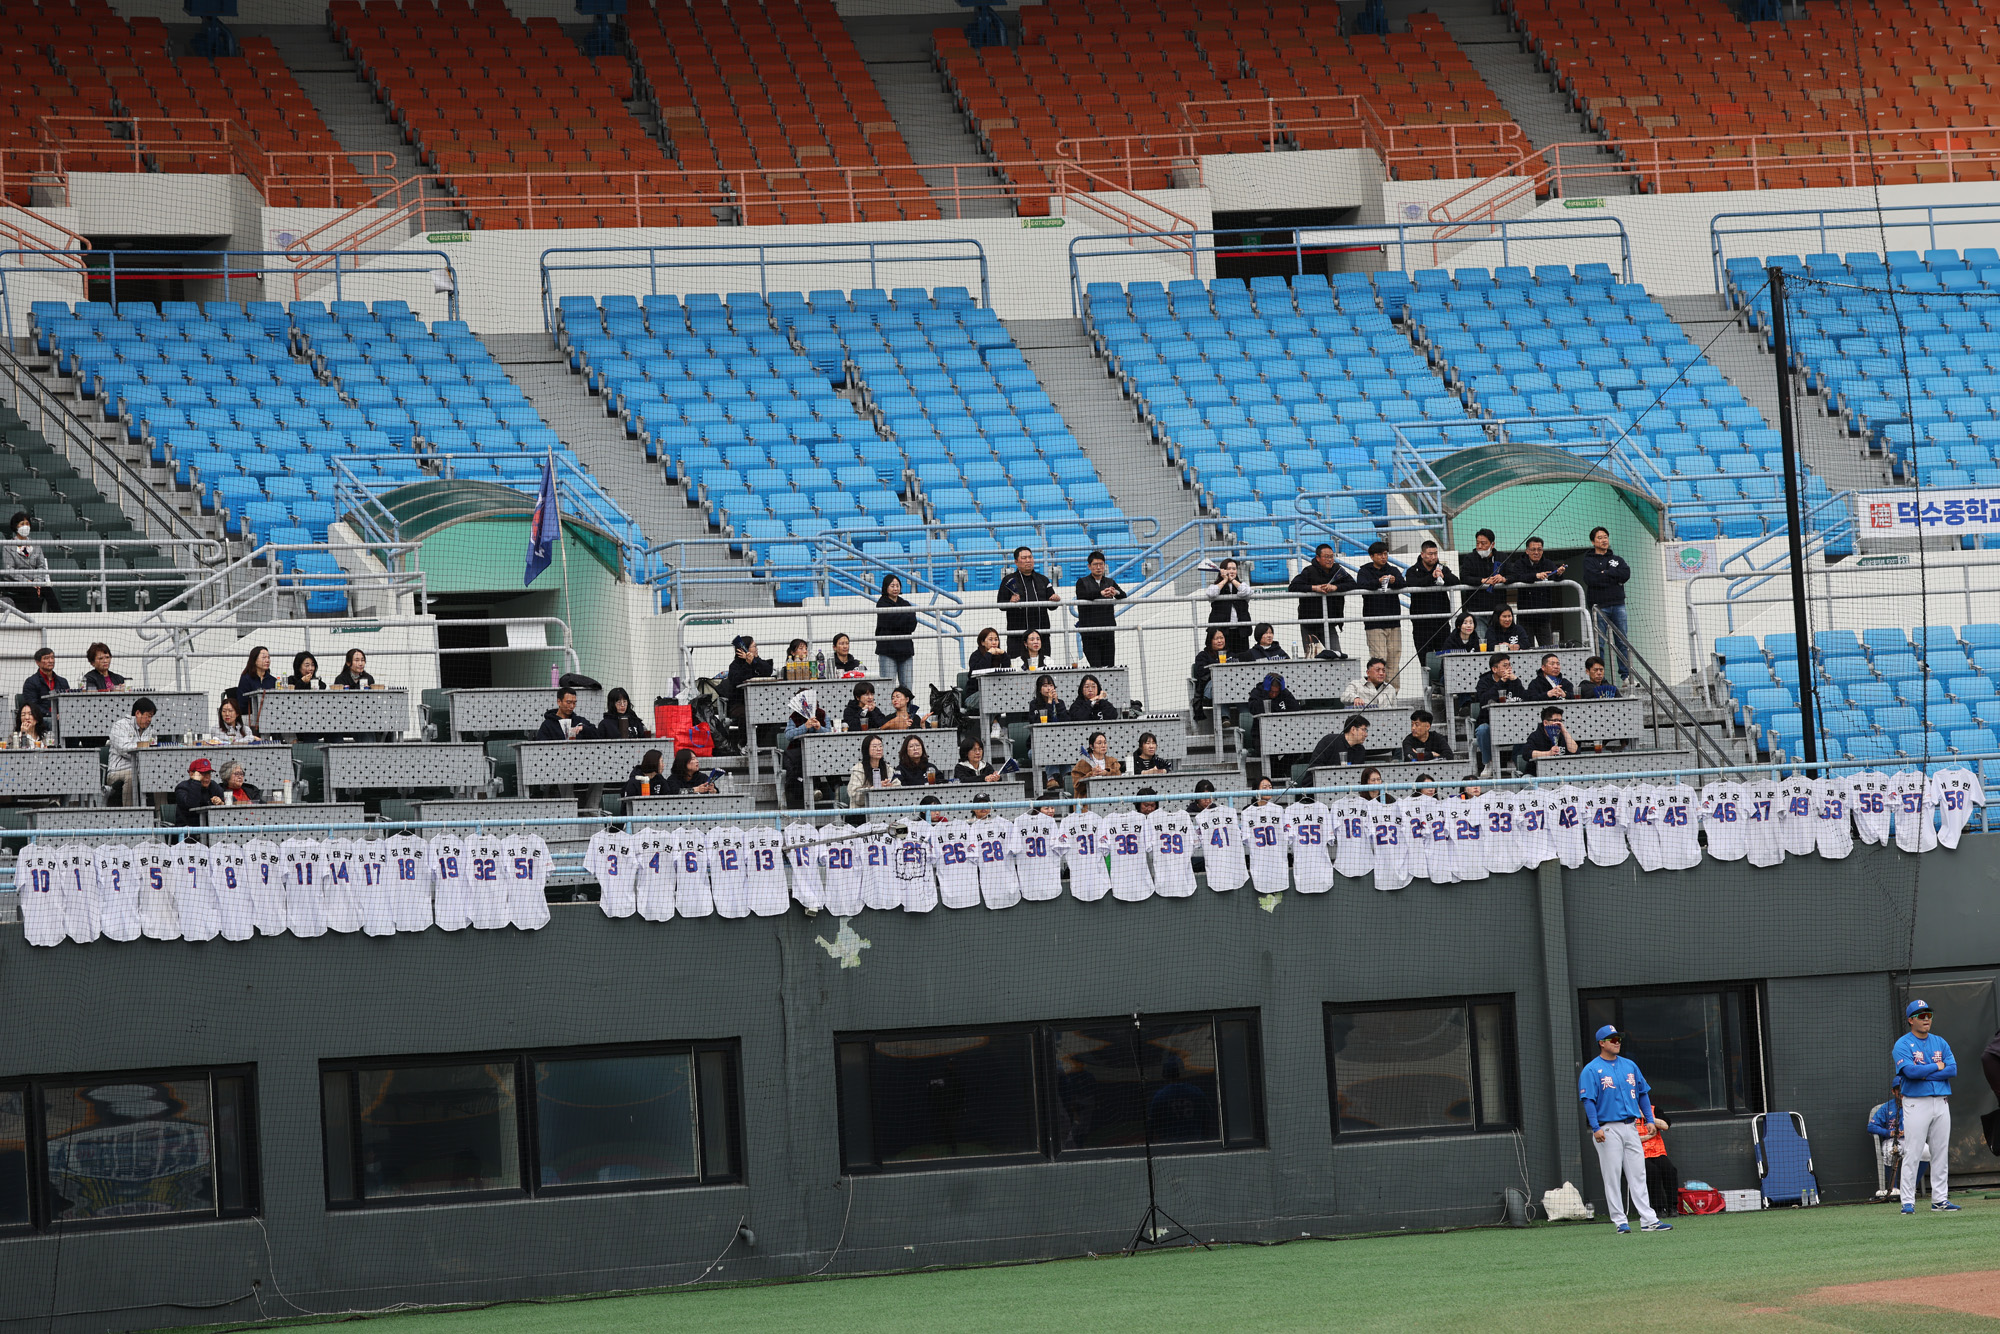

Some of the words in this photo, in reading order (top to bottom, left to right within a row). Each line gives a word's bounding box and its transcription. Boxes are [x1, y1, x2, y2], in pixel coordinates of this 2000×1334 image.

[1789, 797, 1809, 816] 49
[1859, 793, 1884, 813] 56
[1902, 793, 1922, 813] 57
[1944, 790, 1964, 810] 58
[1488, 812, 1512, 832] 33
[1524, 810, 1544, 831] 37
[1559, 806, 1578, 828] 42
[1593, 807, 1616, 828] 43
[1664, 806, 1688, 826] 45
[1712, 802, 1736, 822] 46
[1210, 827, 1230, 848] 41
[1253, 826, 1277, 847] 50
[1298, 825, 1320, 844] 55
[1344, 818, 1361, 838] 16
[1376, 825, 1398, 845] 23
[1410, 818, 1422, 838] 2
[1432, 820, 1447, 841] 2
[942, 842, 966, 865] 26
[981, 840, 1004, 862] 28
[1026, 837, 1047, 858] 30
[1076, 834, 1094, 855] 31
[1115, 834, 1138, 855] 36
[1160, 834, 1184, 854] 39
[608, 855, 618, 876] 3
[649, 852, 660, 874] 4
[685, 852, 698, 873] 6
[719, 850, 738, 871] 12
[754, 850, 774, 871] 13
[829, 848, 852, 869] 20
[868, 845, 888, 866] 21
[150, 867, 162, 890] 5
[188, 867, 196, 888] 7
[225, 867, 237, 888] 8
[261, 864, 268, 885] 9
[296, 862, 312, 885] 11
[330, 862, 349, 884] 14
[364, 864, 380, 885] 17
[398, 858, 415, 880] 18
[439, 857, 458, 879] 19
[474, 858, 496, 880] 32
[514, 858, 533, 880] 51
[32, 869, 50, 892] 10
[74, 868, 81, 891] 1
[112, 869, 120, 891] 2
